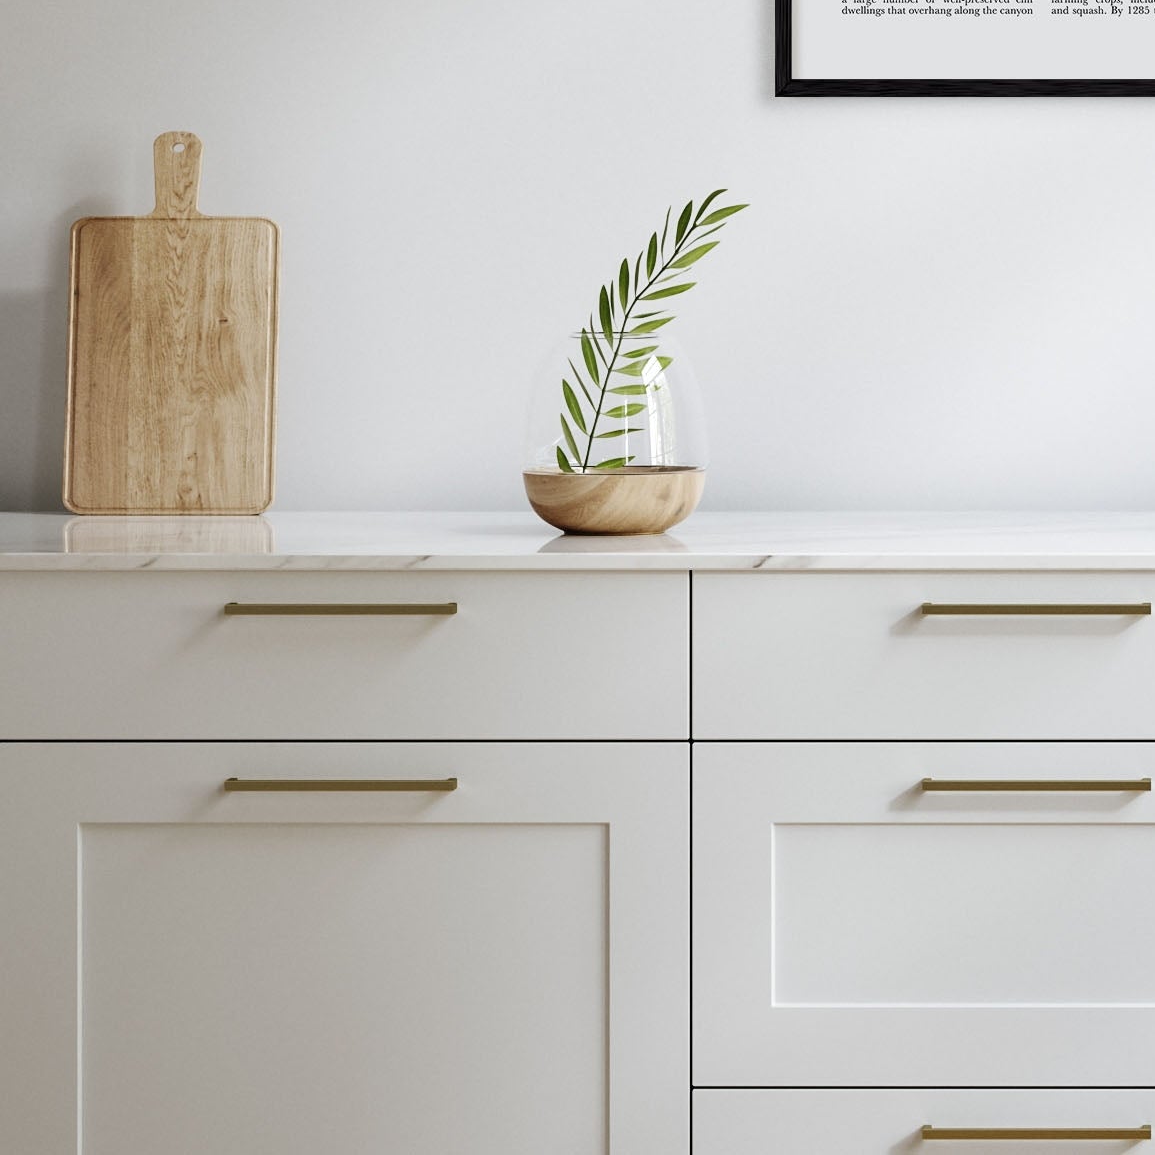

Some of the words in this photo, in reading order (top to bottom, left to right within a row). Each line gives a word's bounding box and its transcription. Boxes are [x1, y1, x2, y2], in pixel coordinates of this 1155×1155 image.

[841, 6, 886, 17] dwellings
[888, 6, 906, 15] that
[908, 6, 952, 17] overhang
[954, 6, 981, 17] along
[983, 6, 998, 15] the
[999, 7, 1033, 17] canyon
[1051, 6, 1069, 15] and
[1072, 6, 1107, 17] squash.
[1111, 6, 1124, 17] By
[1128, 6, 1150, 15] 1285
